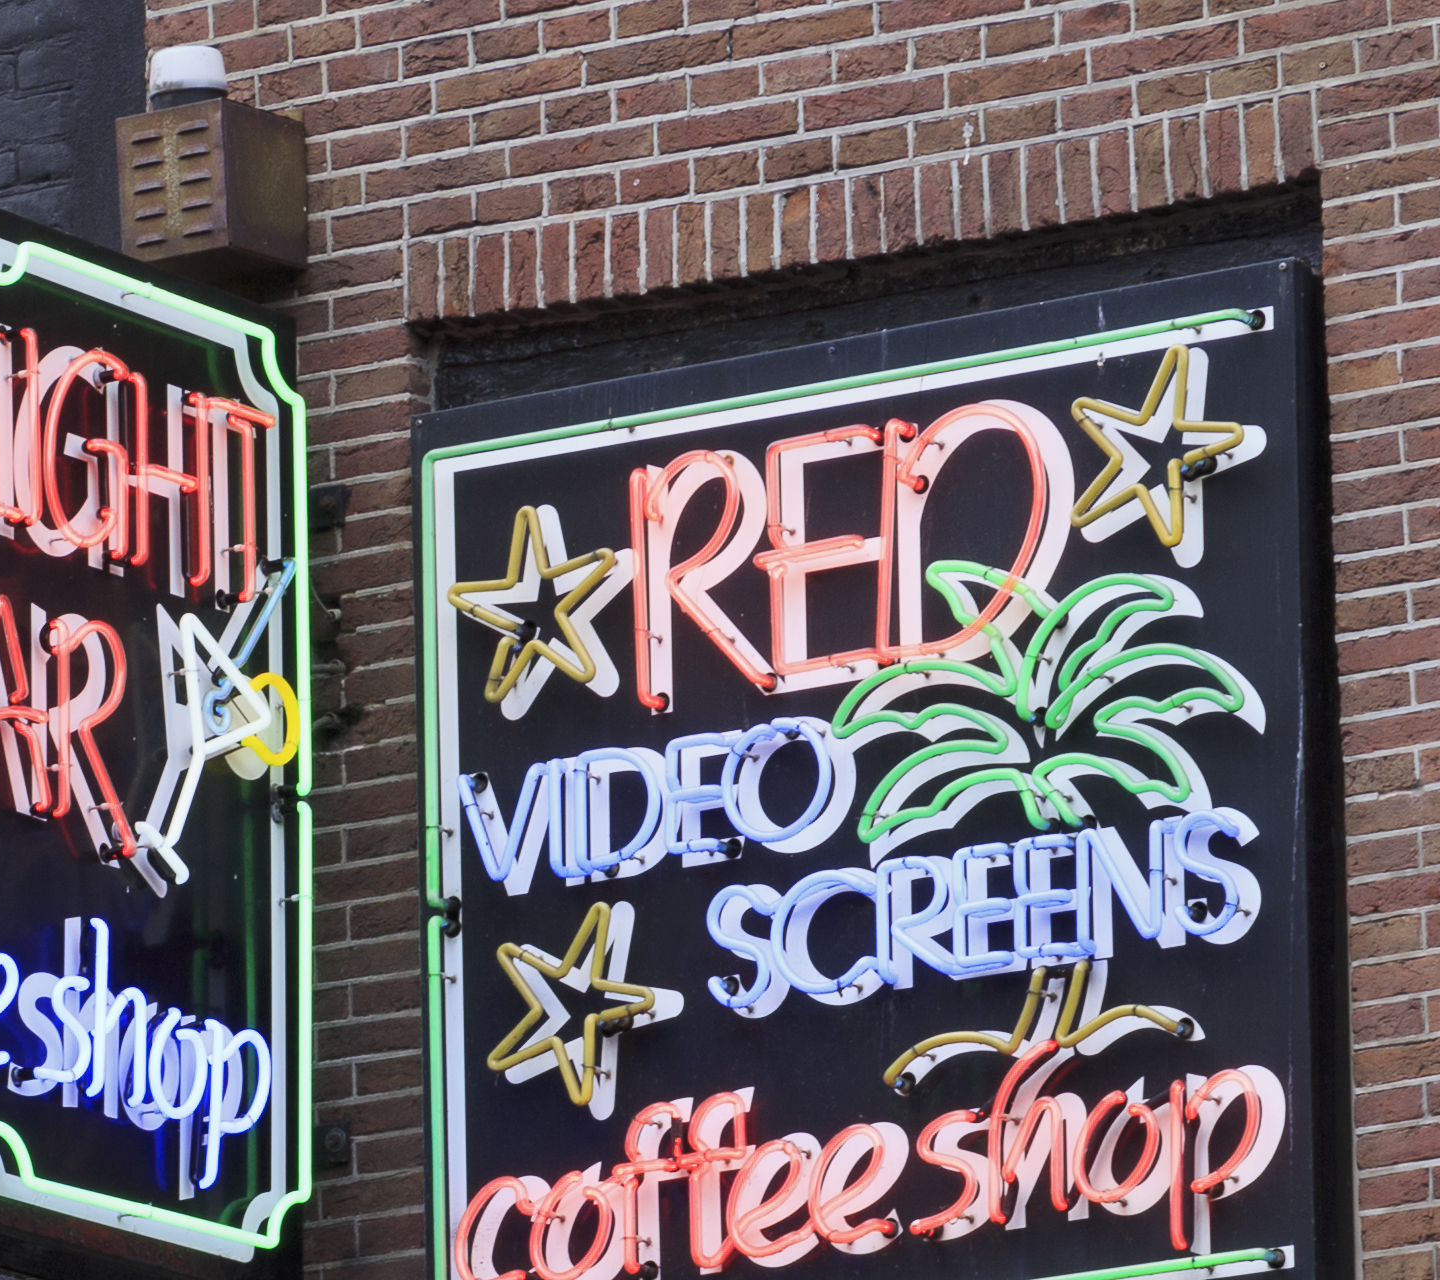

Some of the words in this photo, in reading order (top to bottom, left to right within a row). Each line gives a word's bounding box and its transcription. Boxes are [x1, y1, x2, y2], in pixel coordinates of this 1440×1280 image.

[628, 399, 1075, 714] RED
[457, 716, 858, 898] VIDEO
[706, 806, 1263, 1018] SCREENS
